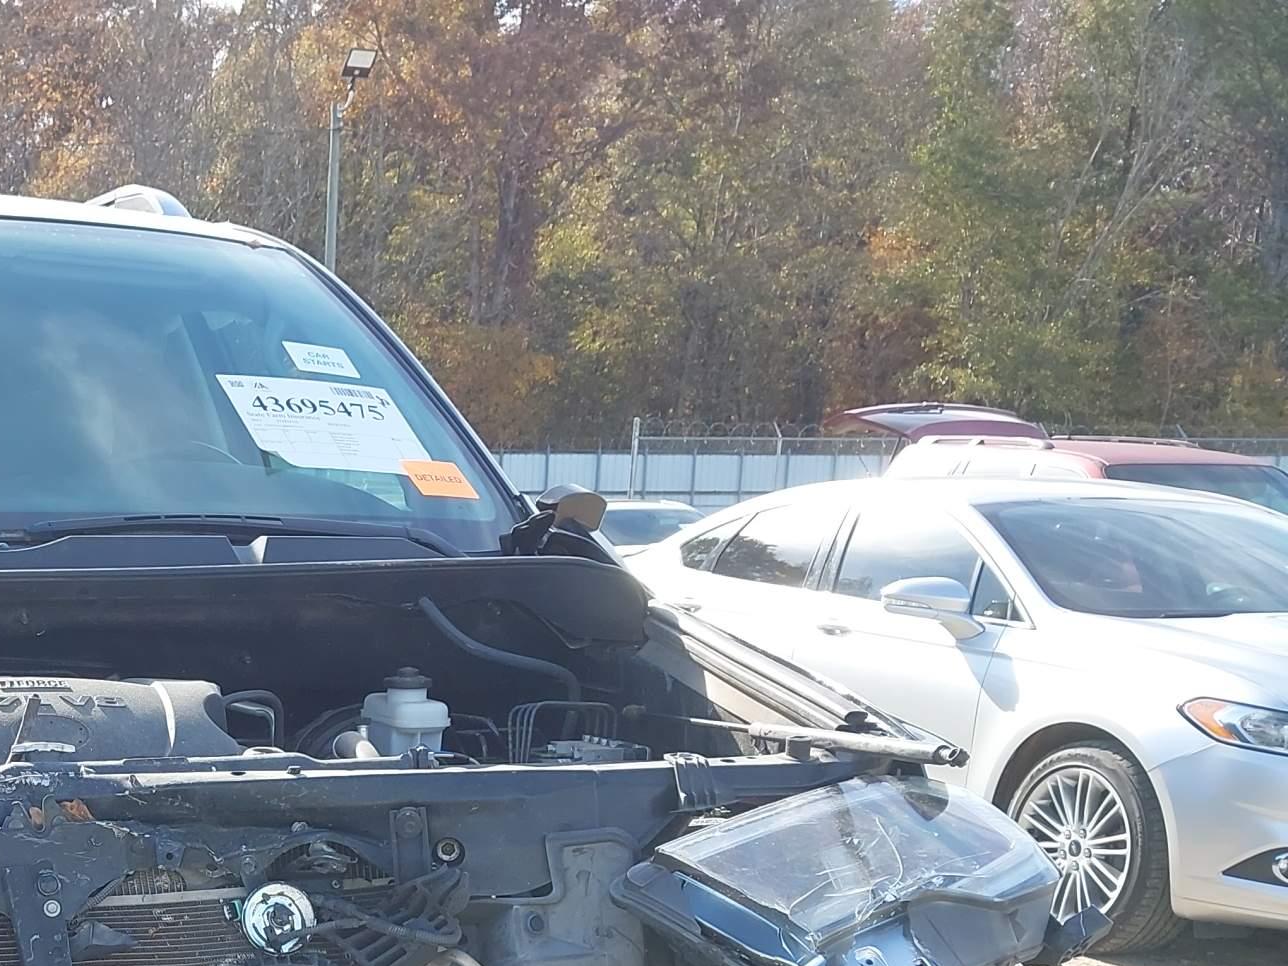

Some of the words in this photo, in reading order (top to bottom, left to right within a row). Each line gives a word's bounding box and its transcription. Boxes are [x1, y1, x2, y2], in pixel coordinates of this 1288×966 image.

[307, 351, 331, 360] CAR
[302, 358, 345, 369] STARTS
[252, 395, 385, 421] 43695475
[414, 473, 465, 484] DETAILED
